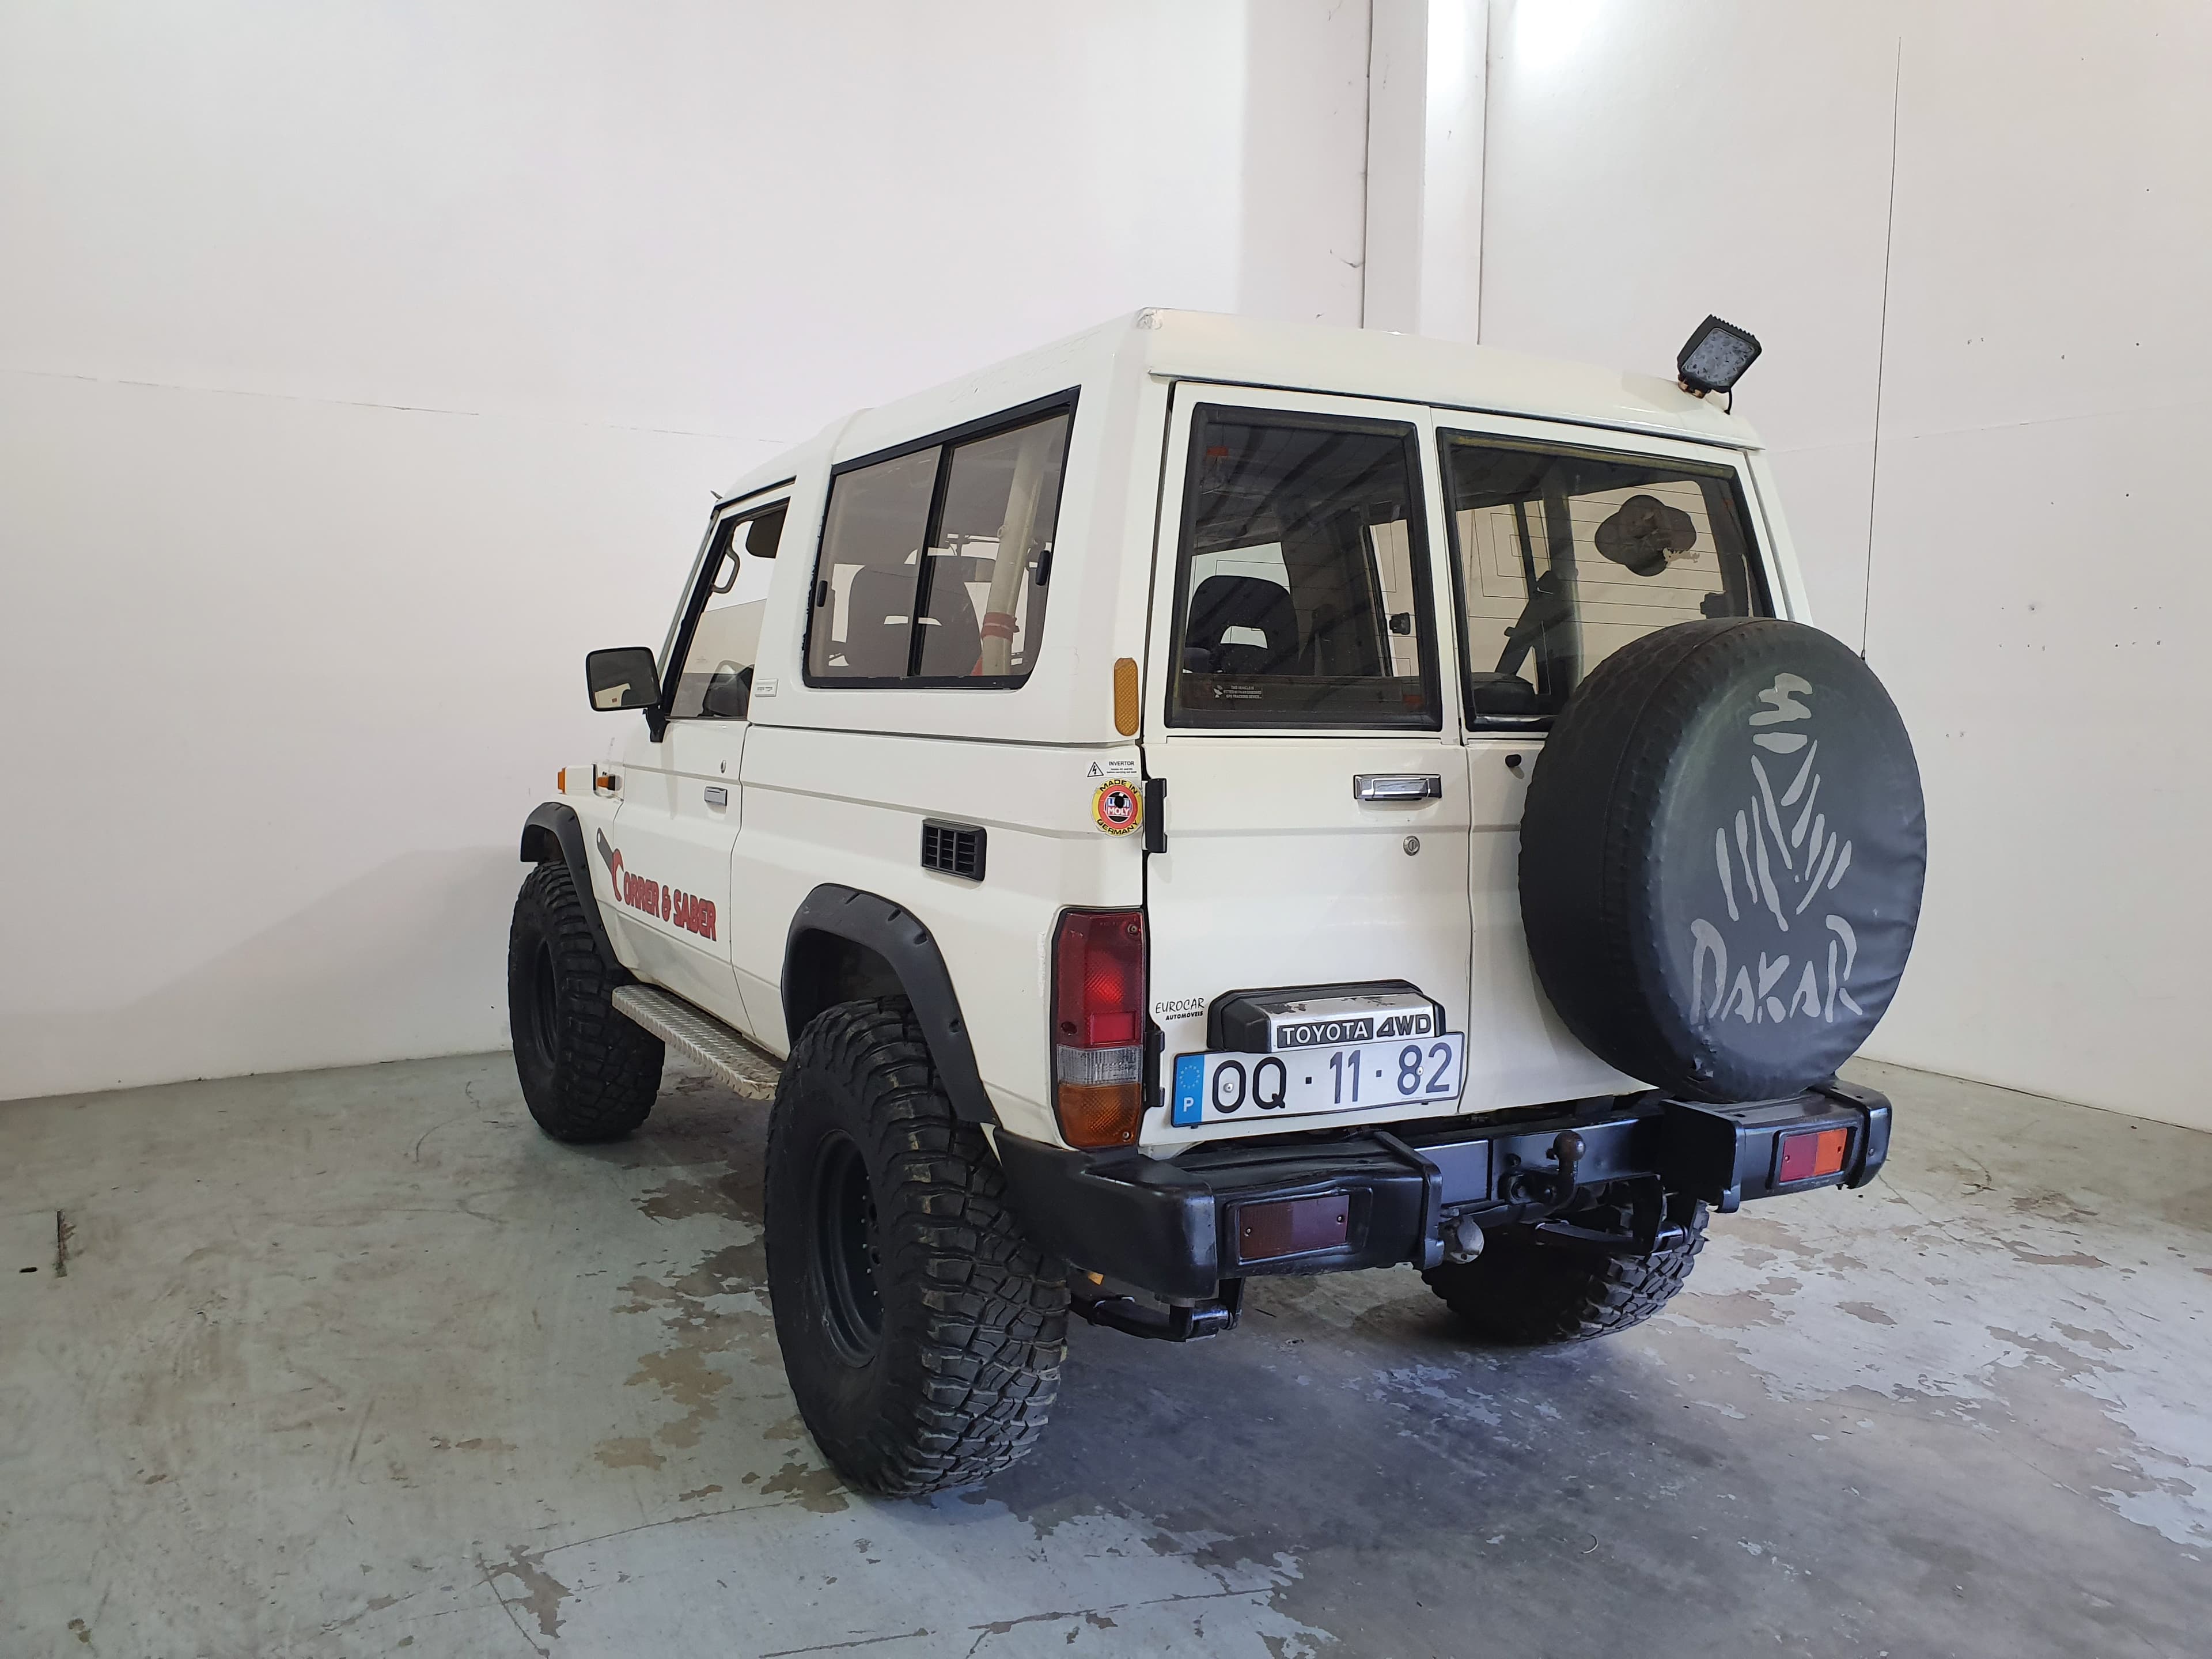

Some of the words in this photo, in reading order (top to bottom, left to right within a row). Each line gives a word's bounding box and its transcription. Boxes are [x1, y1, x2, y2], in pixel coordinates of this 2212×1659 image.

[1100, 779, 1127, 792] MADE
[1129, 784, 1138, 794] IN
[1108, 807, 1130, 816] MOLY
[1097, 819, 1139, 835] GERMANY
[673, 889, 717, 942] SABER
[1690, 914, 1862, 1023] DAKAR
[1155, 998, 1205, 1014] EUROCAR
[1282, 1021, 1368, 1044] TOYOTA
[1376, 1014, 1431, 1038] 4WD
[1183, 1097, 1194, 1112] P
